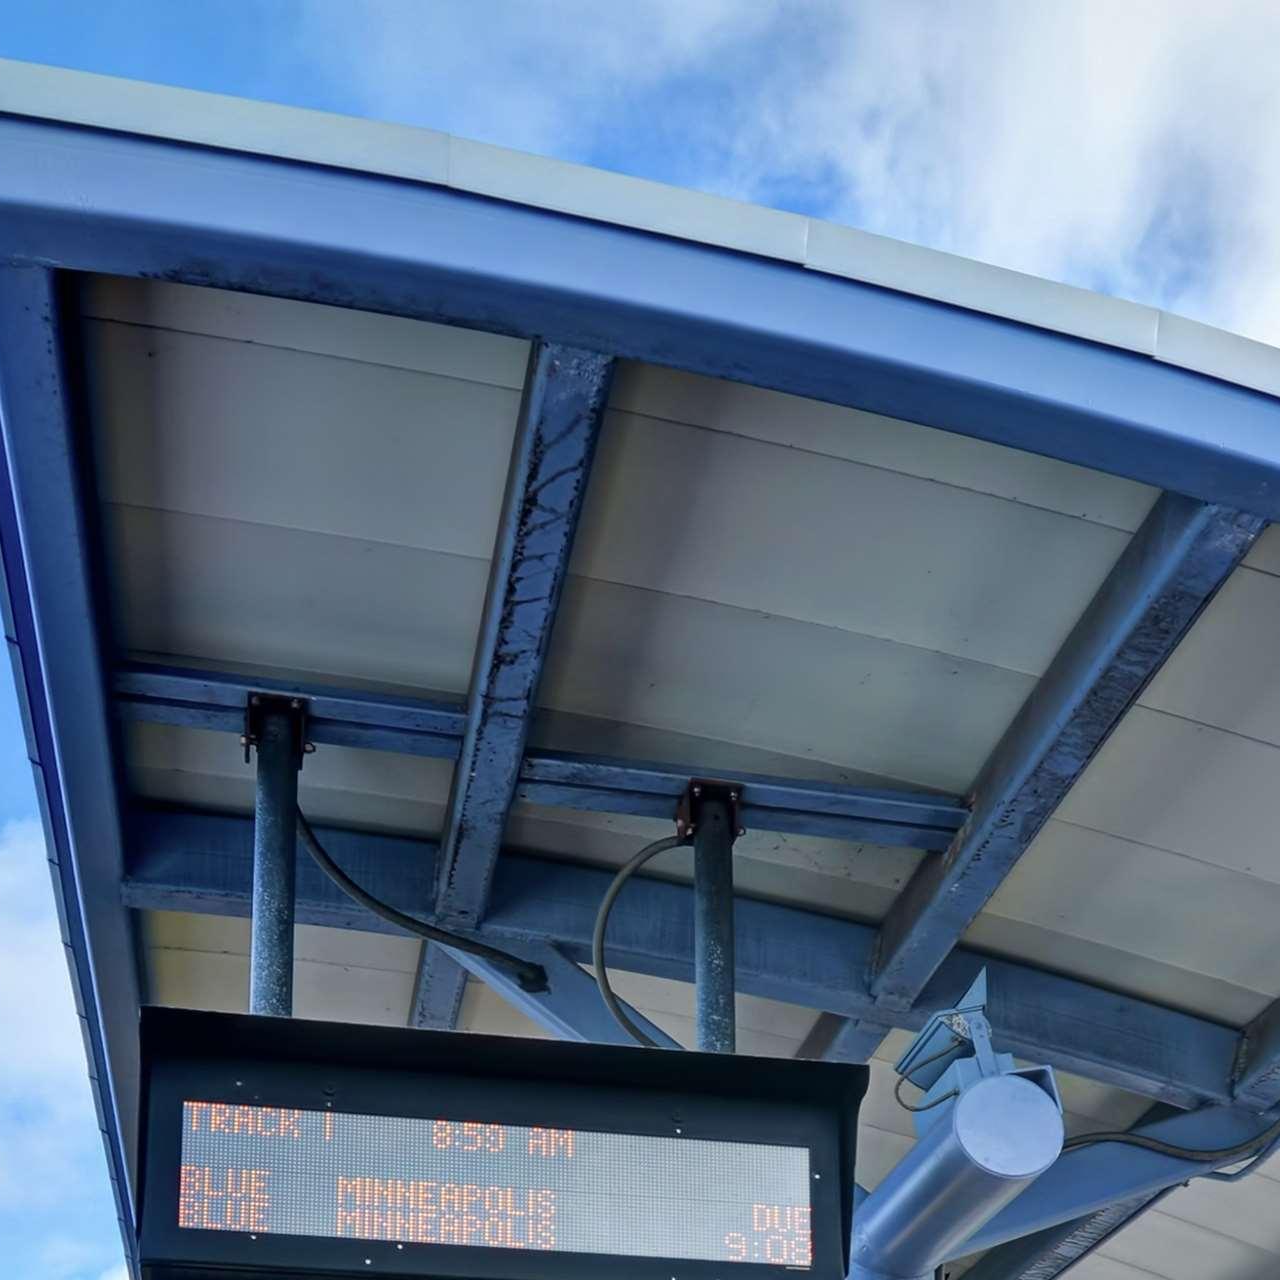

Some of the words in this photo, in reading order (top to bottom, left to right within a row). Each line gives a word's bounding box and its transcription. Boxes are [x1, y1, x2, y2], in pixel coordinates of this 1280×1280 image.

[183, 1100, 302, 1139] TRACK
[324, 1110, 335, 1141] 1
[527, 1125, 575, 1158] AM
[178, 1197, 269, 1231] BLUE
[336, 1208, 556, 1249] MINNEAPOLIS
[724, 1232, 813, 1264] 9:08
[180, 1166, 270, 1198] BLUE
[337, 1175, 556, 1218] MINNEAPOLIS
[752, 1203, 812, 1233] DUE
